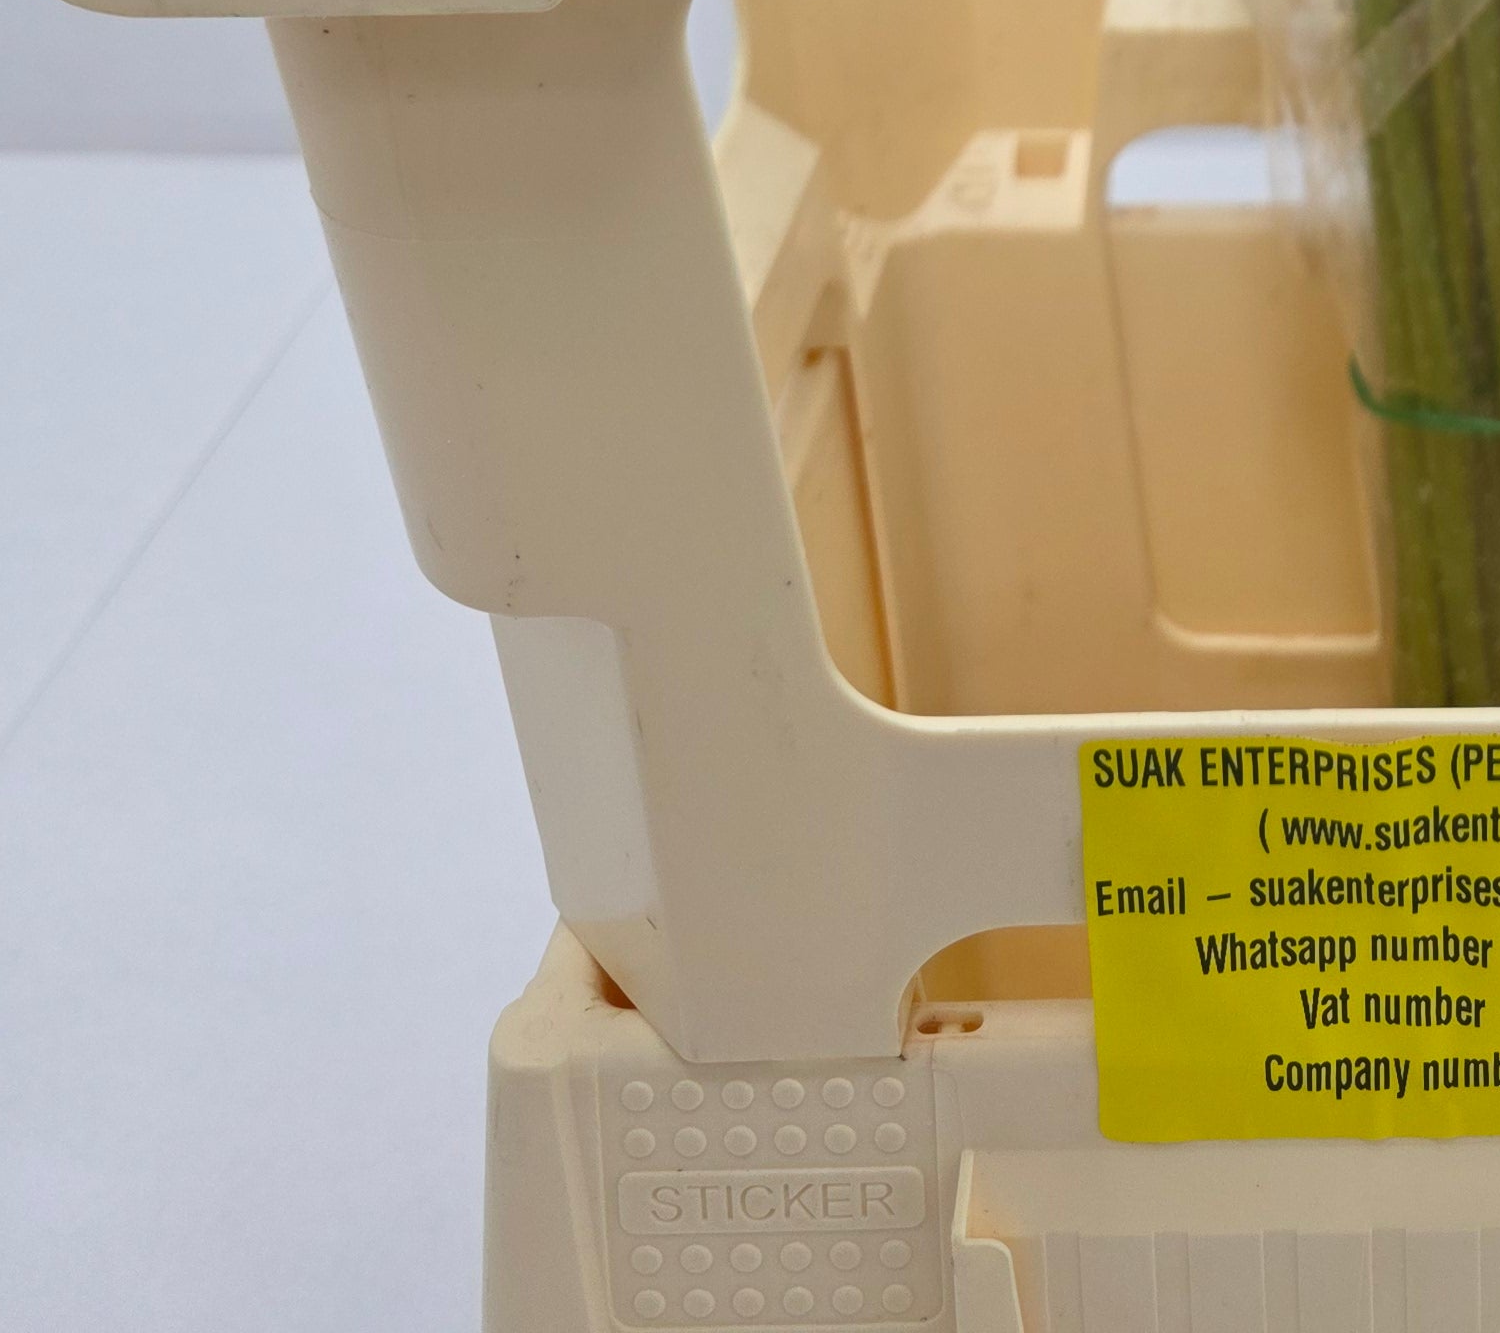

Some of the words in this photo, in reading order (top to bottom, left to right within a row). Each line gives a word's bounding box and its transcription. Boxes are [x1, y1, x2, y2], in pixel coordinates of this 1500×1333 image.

[1092, 747, 1186, 789] SUAK
[1199, 744, 1436, 792] ENTERPRISES
[1095, 876, 1186, 917] Email
[1194, 931, 1357, 975] Whatsapp
[1371, 925, 1493, 969] number
[1299, 987, 1351, 1030] Vat
[1364, 985, 1486, 1028] number
[1264, 1054, 1411, 1100] Company
[650, 1182, 895, 1223] STICKER
